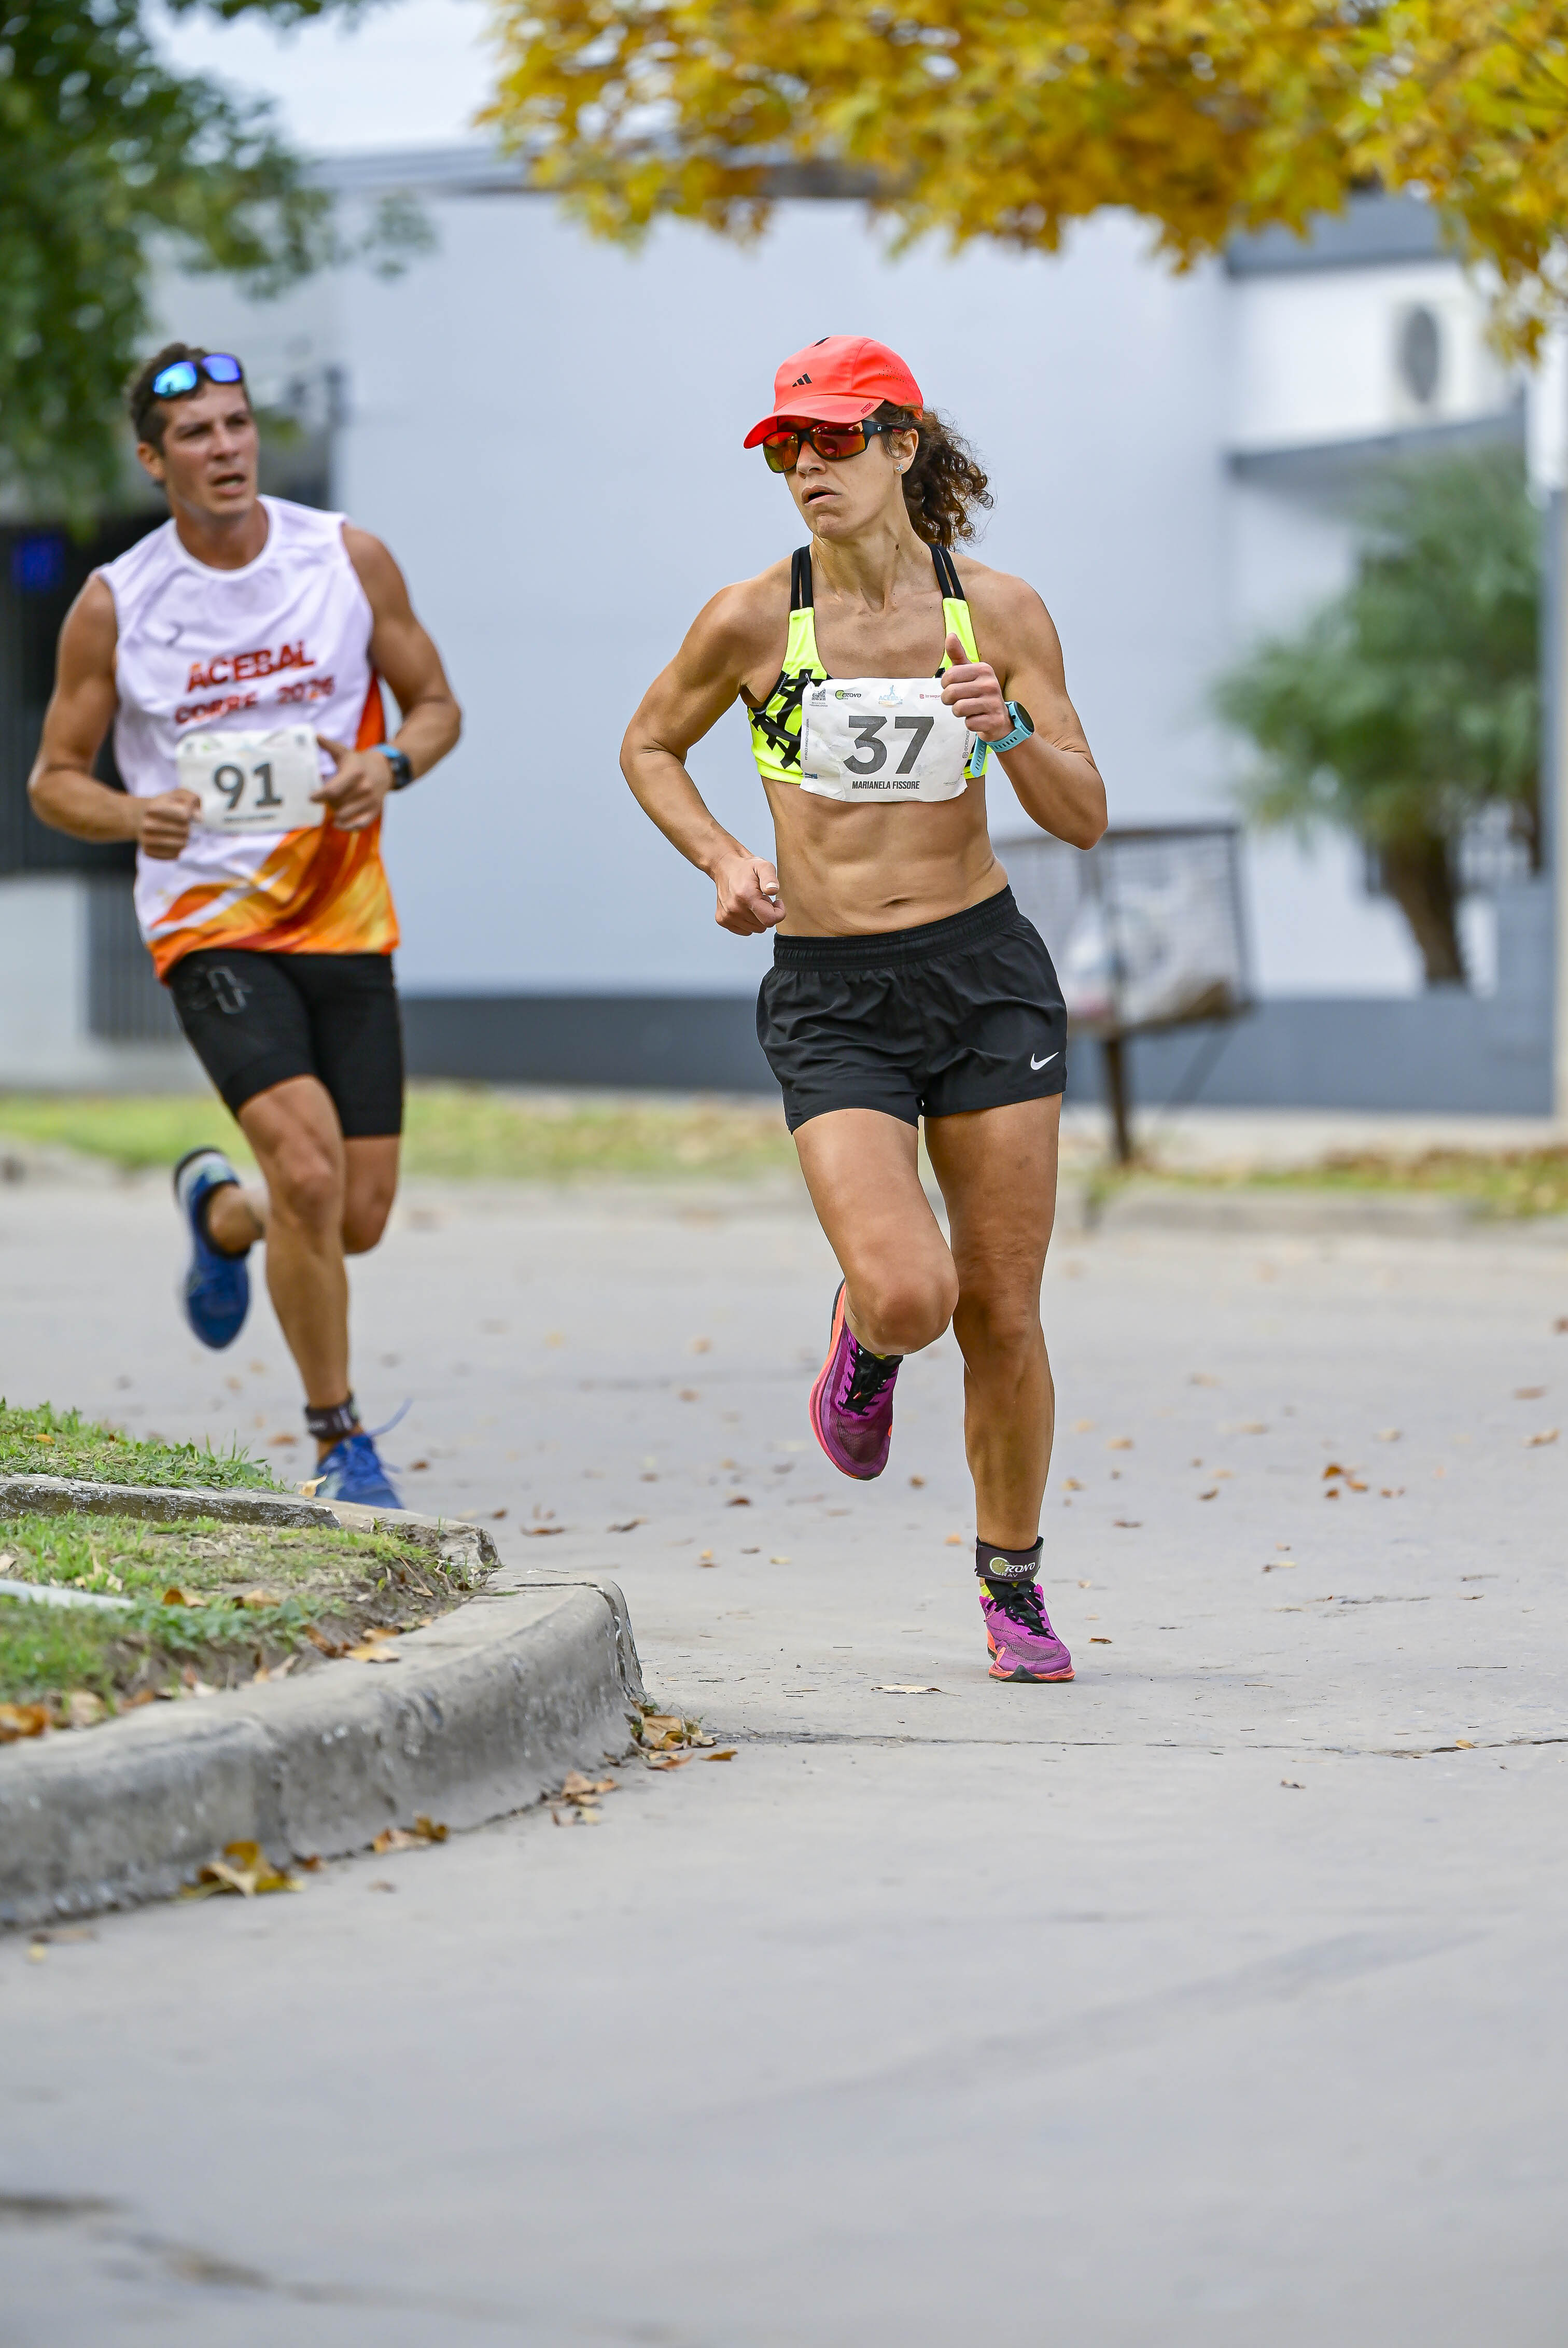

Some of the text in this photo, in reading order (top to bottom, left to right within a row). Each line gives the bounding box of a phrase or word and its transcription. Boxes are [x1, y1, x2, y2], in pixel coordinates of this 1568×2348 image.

[186, 640, 315, 693] ACEBAL
[843, 716, 934, 775] 37
[214, 763, 283, 810] 91
[852, 781, 920, 789] MARIANELA FISSORE
